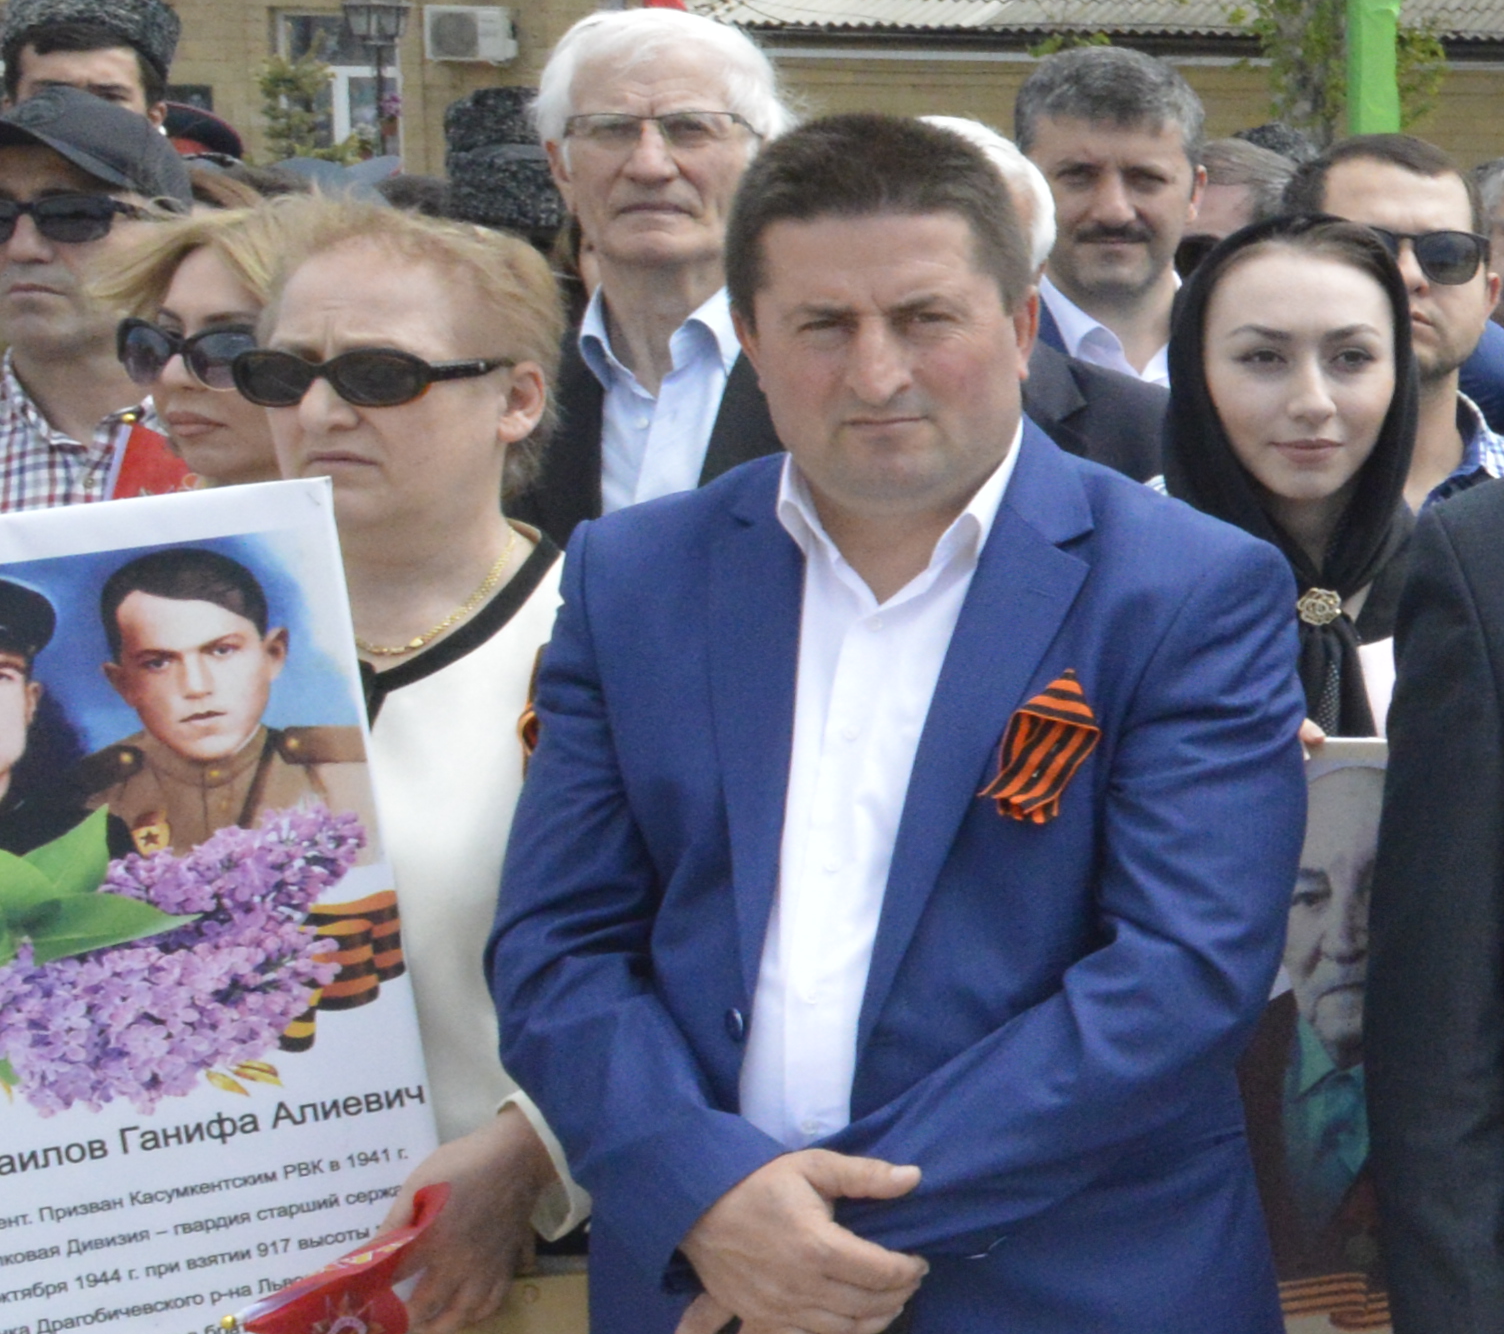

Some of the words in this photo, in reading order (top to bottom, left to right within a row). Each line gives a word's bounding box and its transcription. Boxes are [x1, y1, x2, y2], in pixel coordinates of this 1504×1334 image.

[119, 1111, 260, 1155] Ганифа
[271, 1084, 426, 1130] Алиевич
[39, 1197, 124, 1224] Призван
[129, 1171, 278, 1206] Касумкентским
[283, 1159, 325, 1180] РВК
[329, 1159, 341, 1172] в
[346, 1147, 391, 1168] 1941
[397, 1147, 409, 1160] г.
[66, 1228, 151, 1258] Дивизия
[173, 1211, 252, 1236] гвардия
[256, 1193, 340, 1220] старший
[0, 1281, 68, 1304] ктября
[75, 1268, 122, 1290] 1944
[128, 1267, 140, 1281] г.
[145, 1262, 181, 1281] при
[186, 1248, 252, 1271] взятии
[256, 1238, 292, 1257] 917
[297, 1227, 370, 1250] высоты
[209, 1284, 253, 1306] р-на
